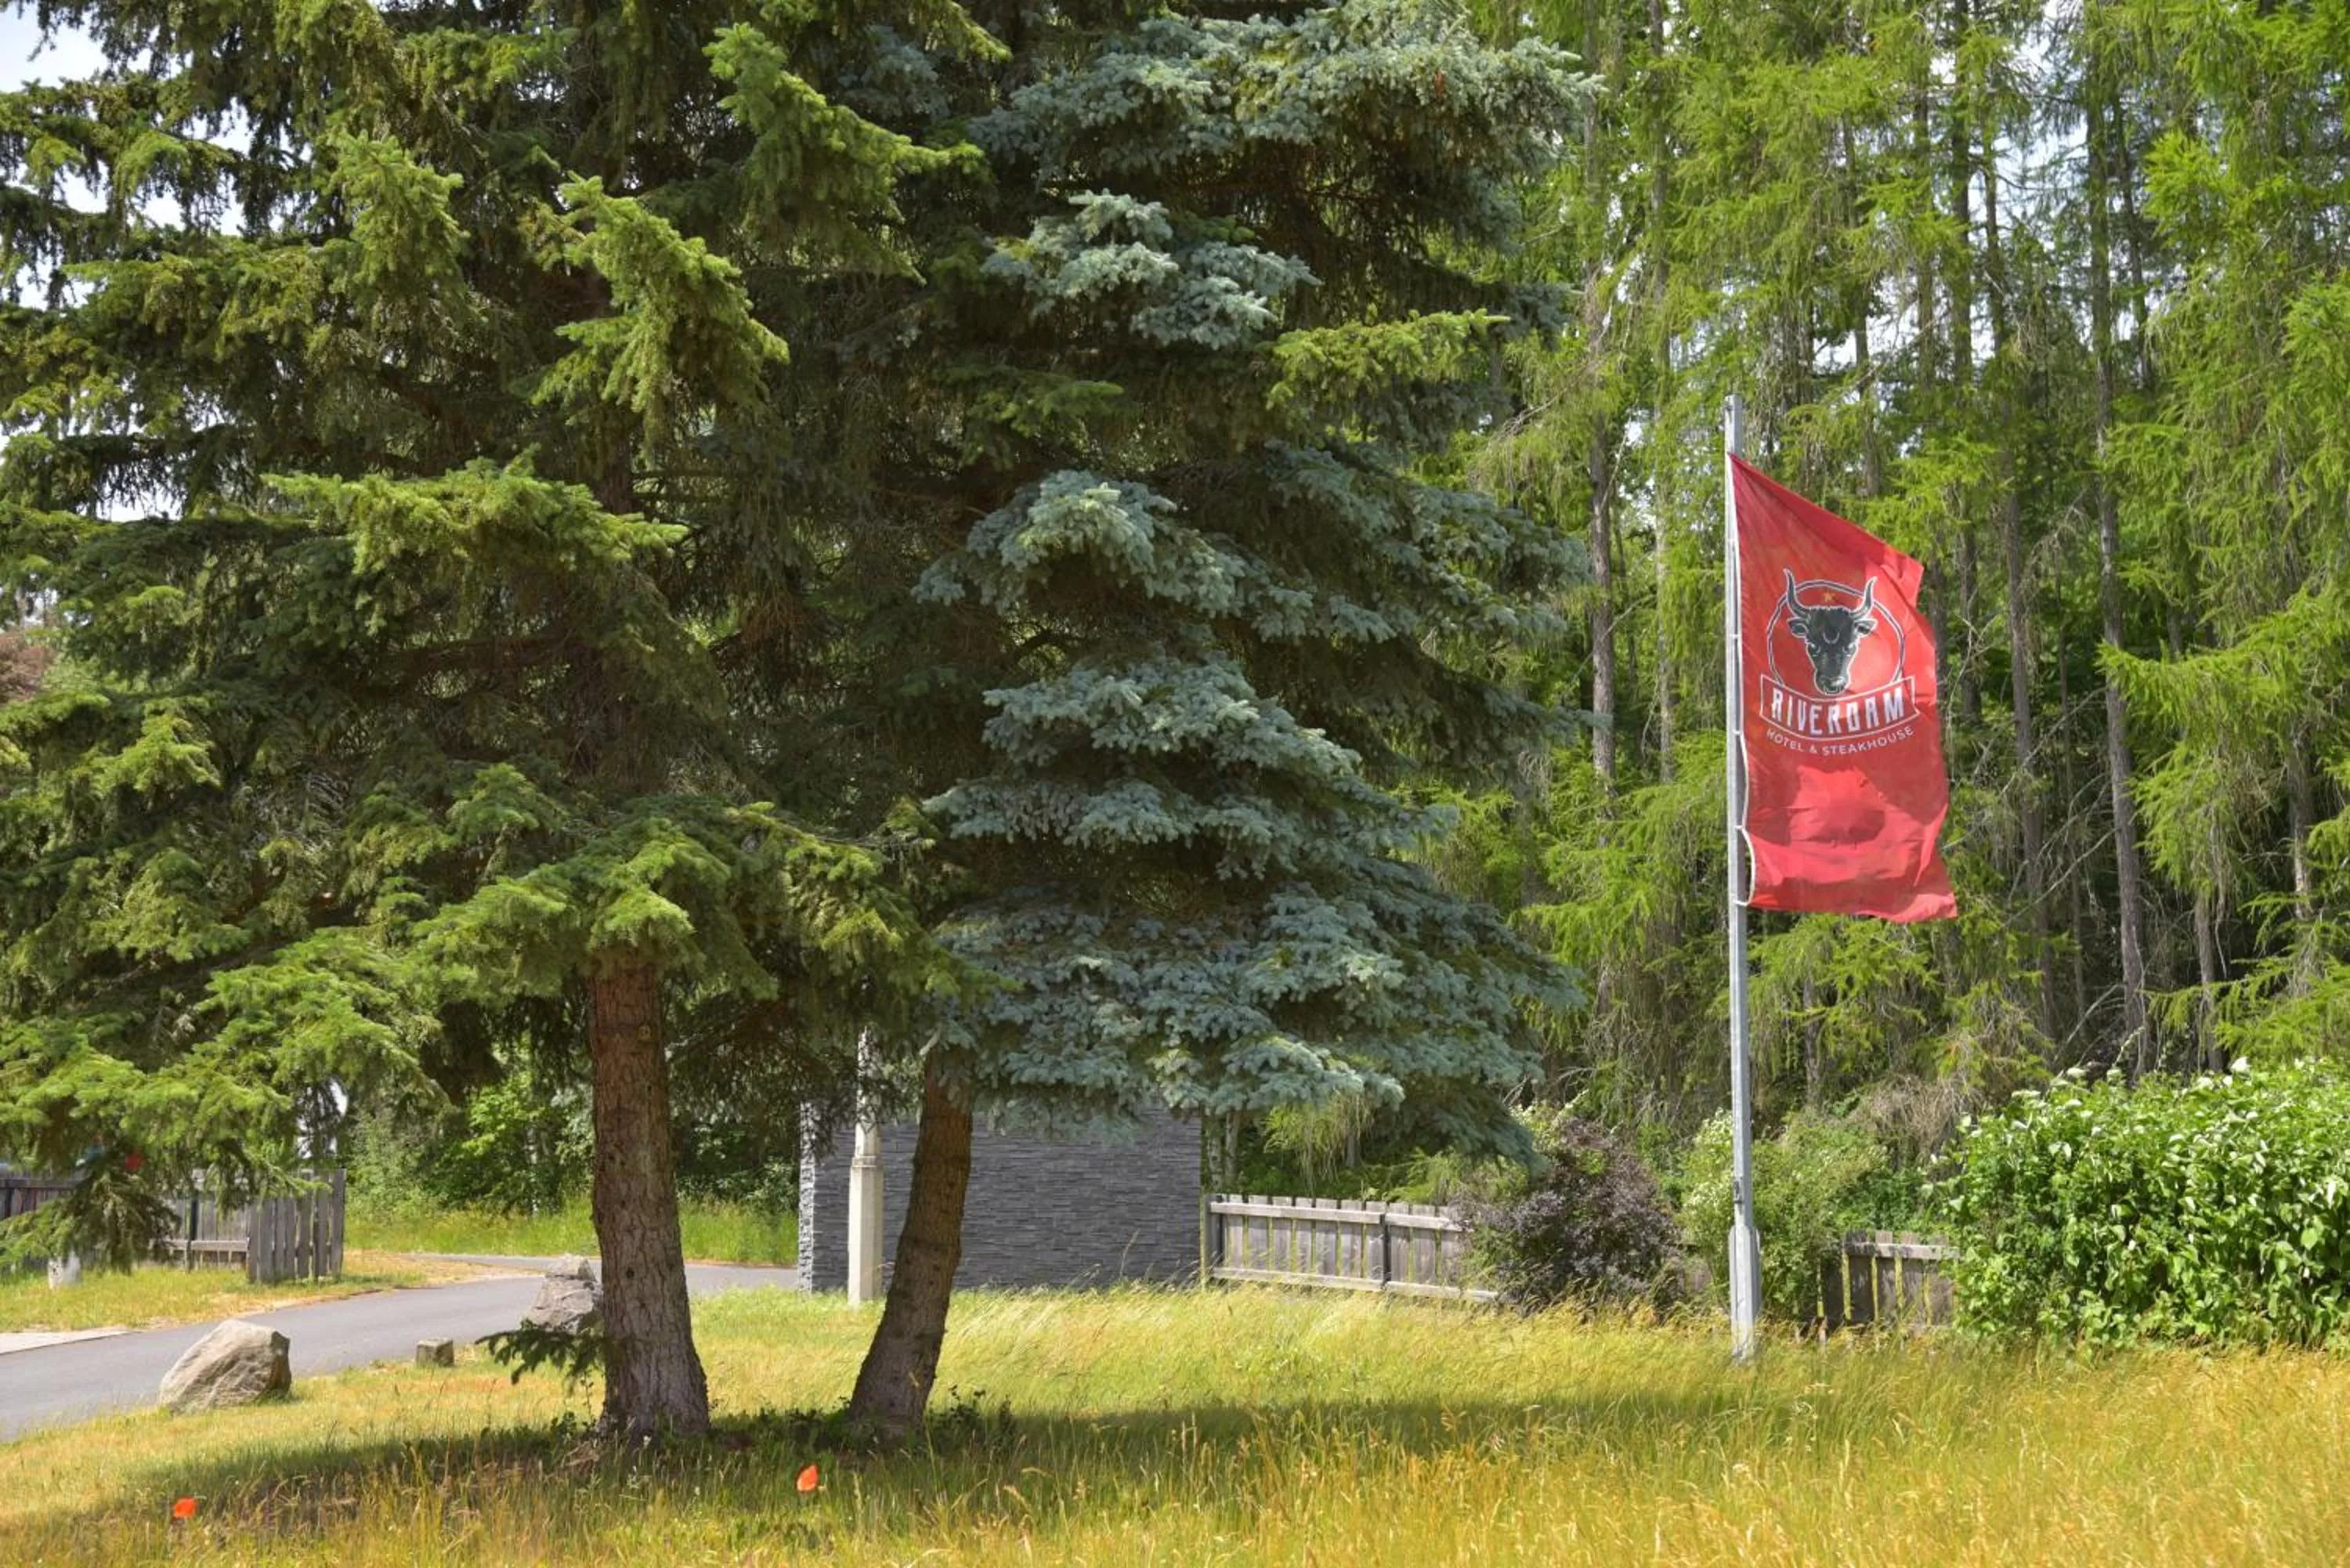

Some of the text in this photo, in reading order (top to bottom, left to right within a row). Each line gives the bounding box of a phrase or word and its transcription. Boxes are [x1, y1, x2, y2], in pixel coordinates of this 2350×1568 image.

[1766, 725, 1914, 756] HOTEL & STEAKHOUSE
